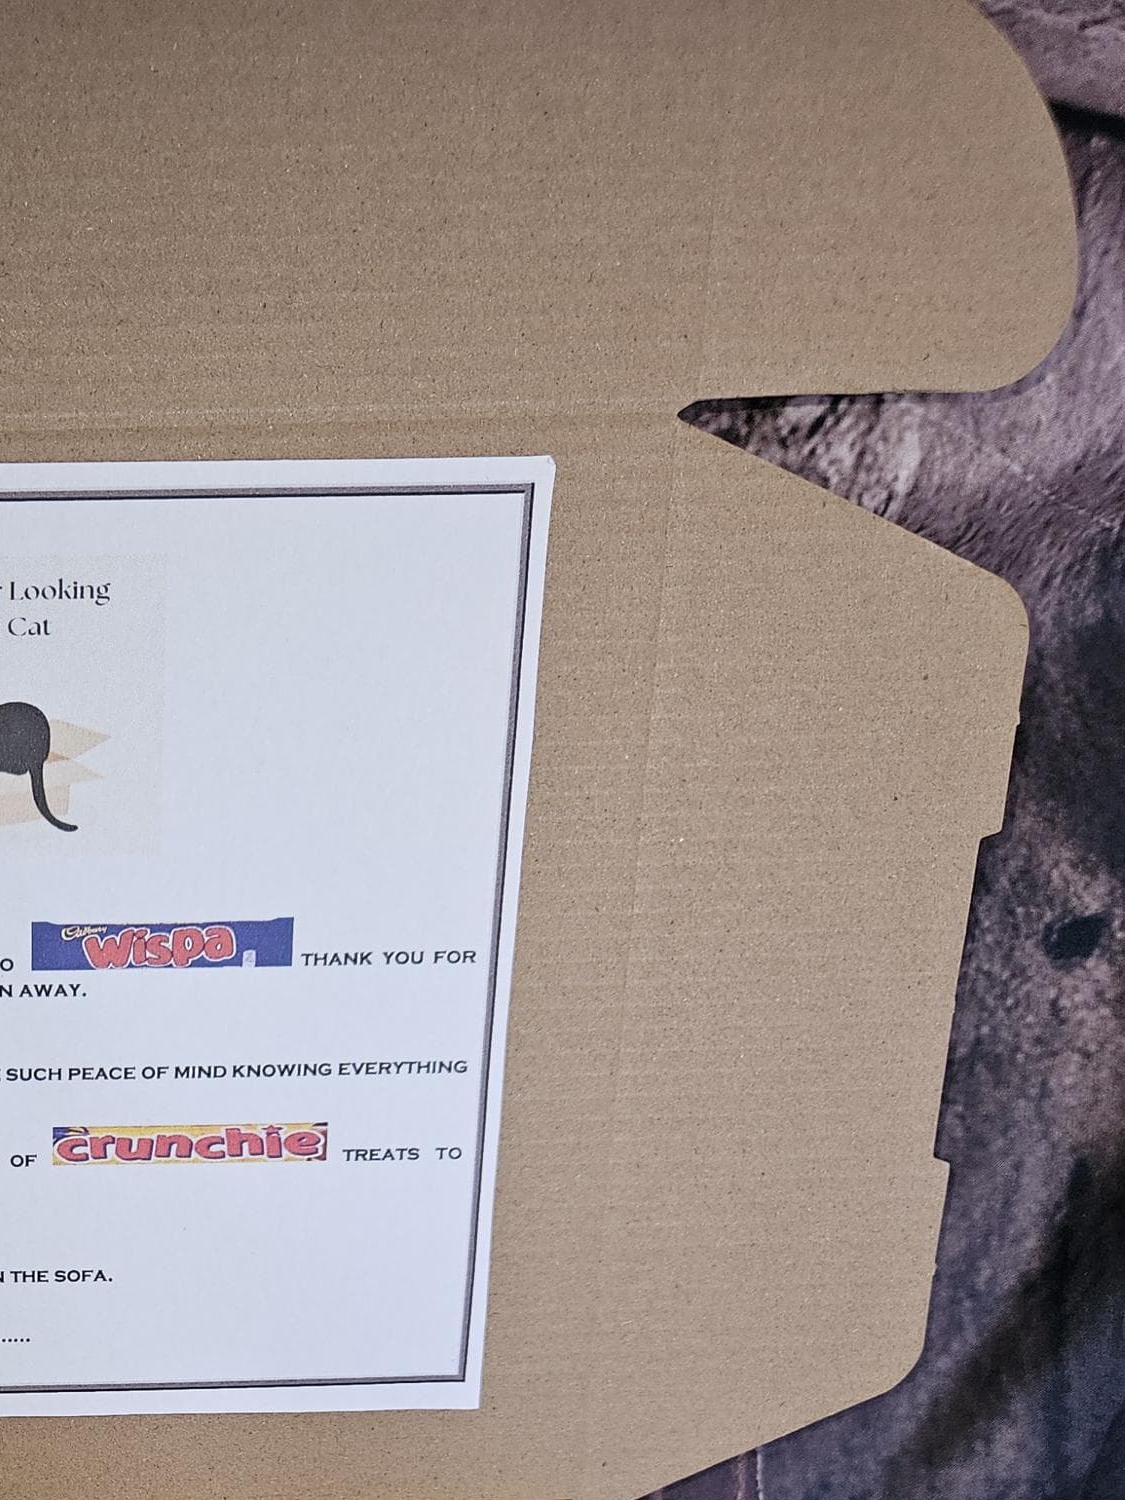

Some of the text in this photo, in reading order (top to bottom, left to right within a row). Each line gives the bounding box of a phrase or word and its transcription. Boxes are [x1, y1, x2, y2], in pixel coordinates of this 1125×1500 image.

[10, 578, 111, 606] Looking
[8, 617, 50, 636] Cat
[82, 926, 236, 969] Wispa
[301, 952, 373, 966] THANK
[383, 951, 424, 965] YOU
[433, 950, 476, 964] FOR
[19, 984, 86, 997] AWAY.
[6, 1068, 62, 1081] SUCH
[68, 1066, 136, 1080] PEACE
[142, 1066, 169, 1079] OF
[174, 1066, 227, 1079] MIND
[232, 1063, 332, 1078] KNOWING
[338, 1060, 467, 1075] EVERYTHING
[10, 1154, 37, 1167] OF
[56, 1125, 324, 1164] crunchie
[342, 1148, 420, 1161] TREATS
[435, 1147, 462, 1160] TO
[10, 1270, 49, 1283] THE
[54, 1270, 112, 1282] SOFA.
